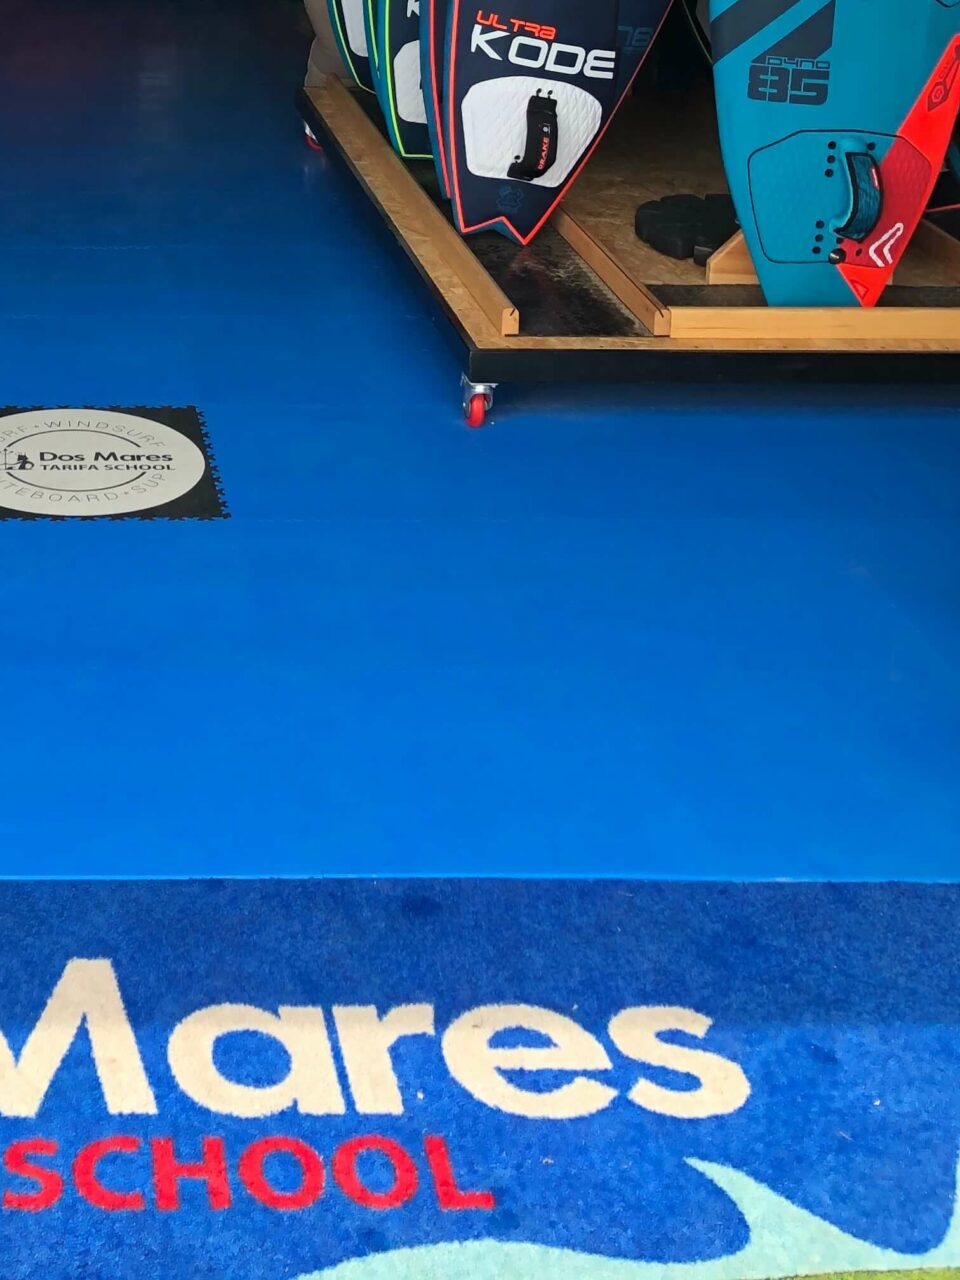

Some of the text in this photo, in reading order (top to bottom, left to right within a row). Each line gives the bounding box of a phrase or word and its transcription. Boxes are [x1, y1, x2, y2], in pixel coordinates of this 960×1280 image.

[476, 10, 557, 41] ULTRA
[470, 24, 616, 80] KODE
[747, 65, 830, 106] 85
[537, 136, 549, 170] DRAKE
[43, 419, 167, 448] WINDSURF
[40, 451, 173, 462] Dos Mares
[130, 472, 167, 494] SUP
[1, 1133, 497, 1212] SCHOOL
